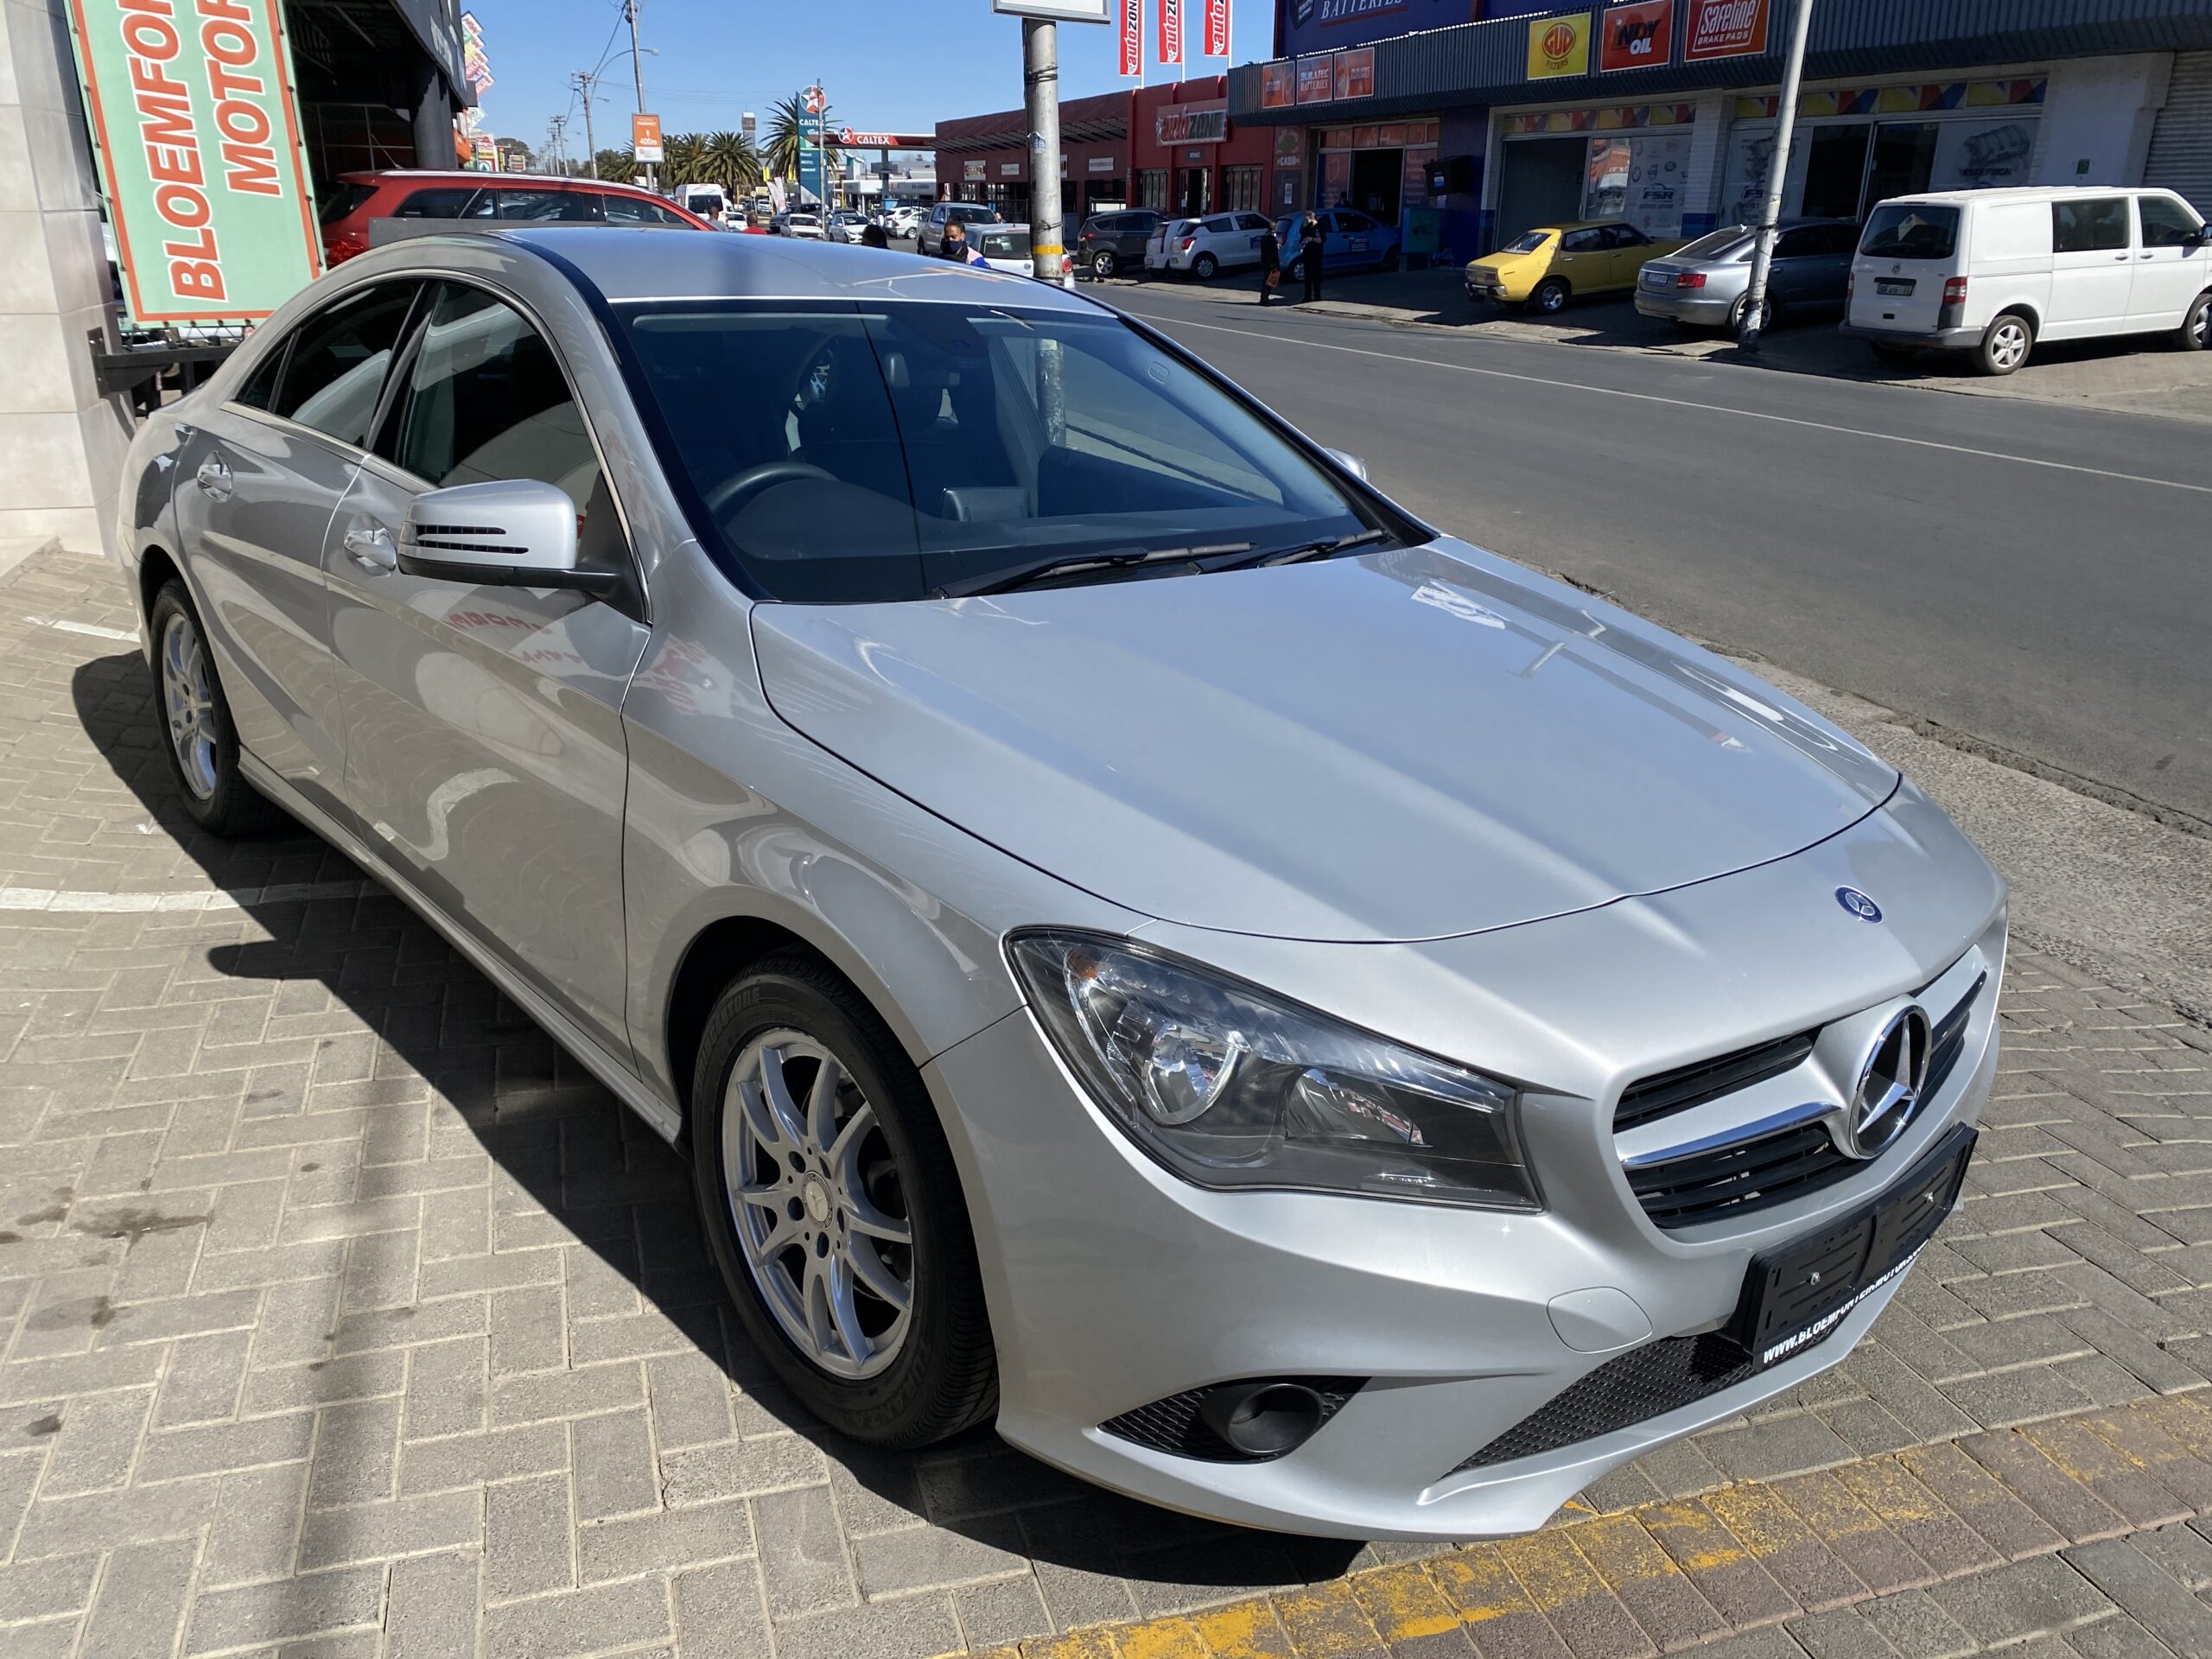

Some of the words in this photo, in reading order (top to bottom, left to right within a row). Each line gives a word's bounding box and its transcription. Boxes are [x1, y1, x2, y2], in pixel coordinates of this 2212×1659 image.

[1697, 34, 1725, 46] BRAKE
[1725, 30, 1749, 42] PADS
[1630, 37, 1652, 55] OIL
[1546, 58, 1569, 70] FILTERS
[1300, 79, 1329, 92] BATTERIES
[196, 0, 283, 198] MOTO
[856, 136, 890, 145] CALTEX
[118, 0, 227, 303] BLOEMFO
[1643, 191, 1675, 200] FSR
